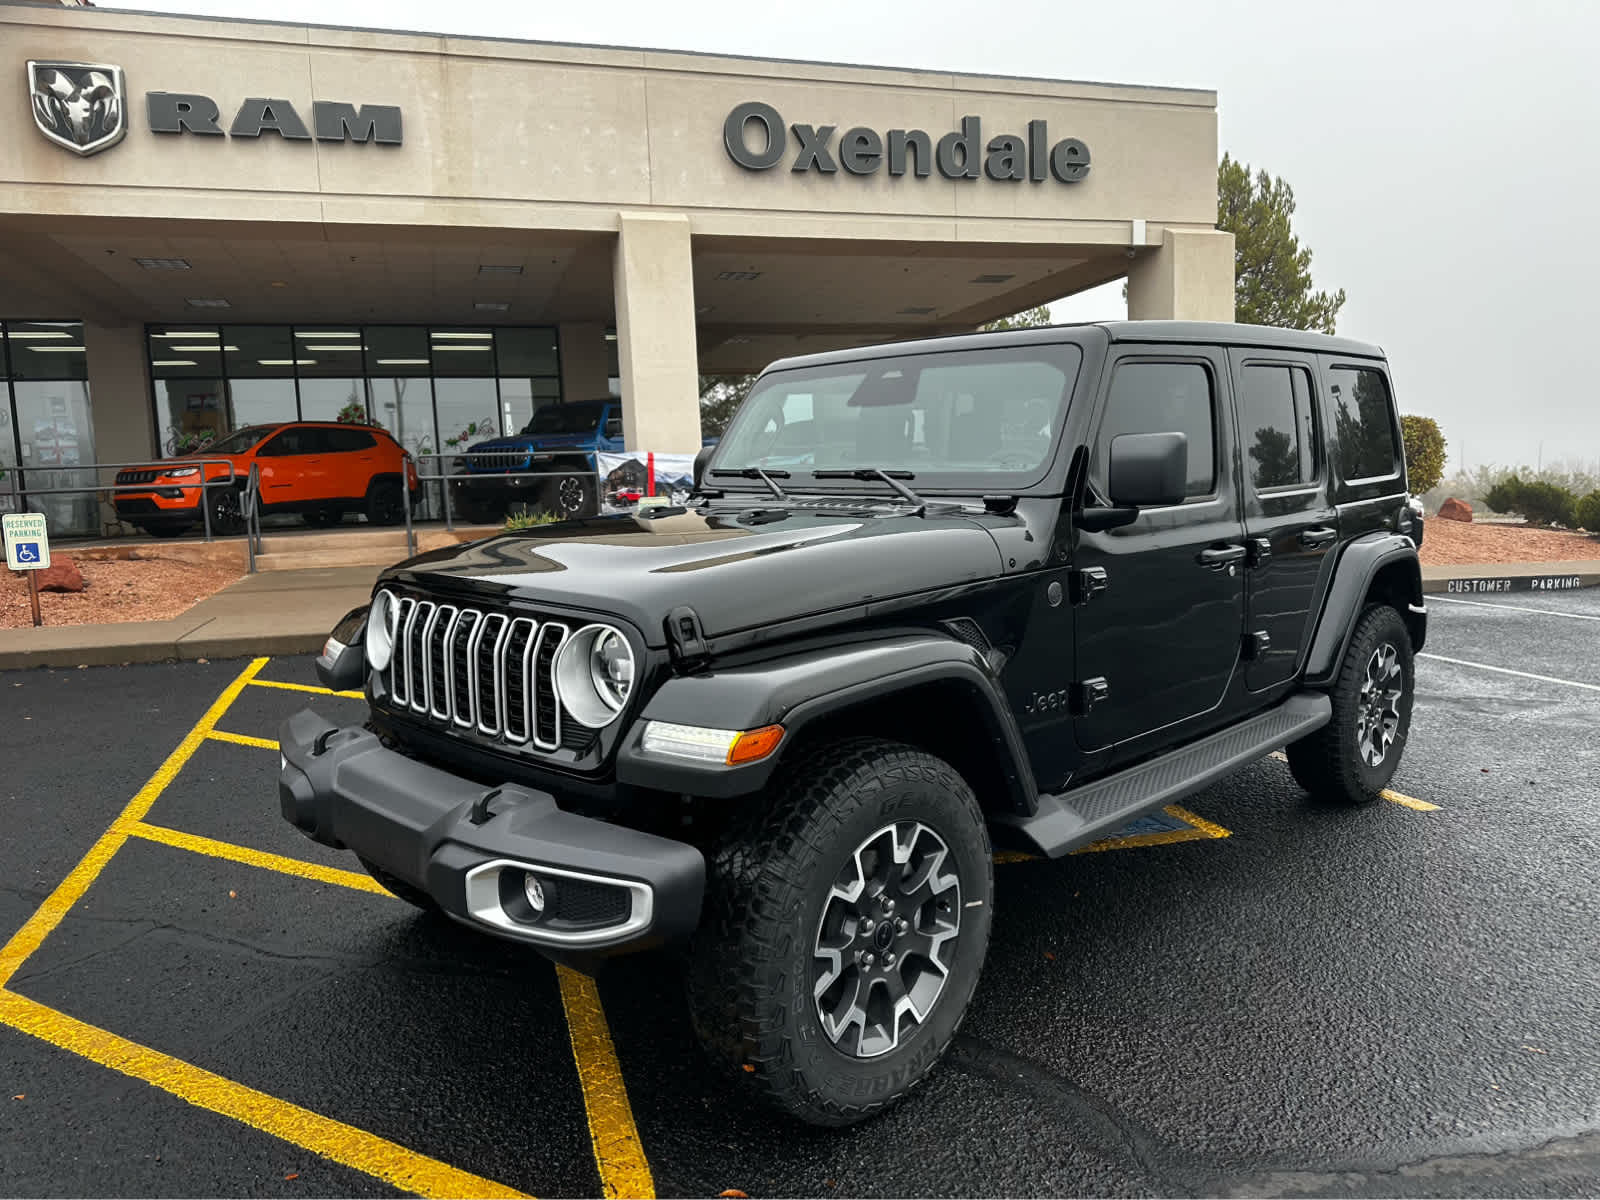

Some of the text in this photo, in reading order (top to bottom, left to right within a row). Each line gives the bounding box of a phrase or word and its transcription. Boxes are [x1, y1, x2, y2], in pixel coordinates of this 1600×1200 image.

[146, 91, 403, 146] RAM
[723, 101, 1092, 184] Oxendale
[6, 519, 43, 529] RESERVED
[9, 529, 42, 537] PARKING
[1447, 577, 1581, 593] CUSTOMER PARKING
[1025, 689, 1067, 713] Jeep
